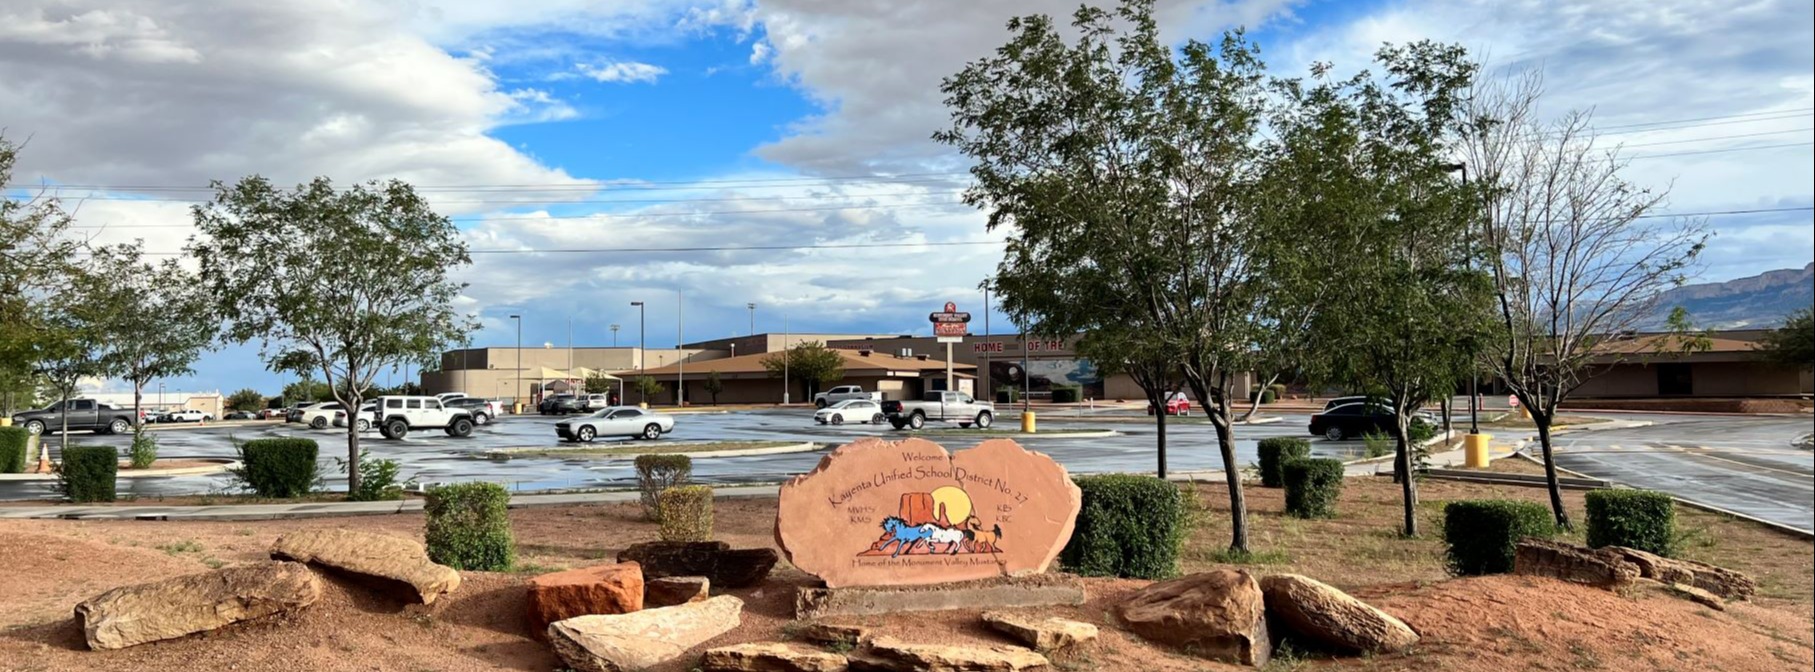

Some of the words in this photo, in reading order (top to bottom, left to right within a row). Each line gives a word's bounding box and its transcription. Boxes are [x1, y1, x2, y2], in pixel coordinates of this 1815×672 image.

[974, 342, 1003, 352] HOME
[1027, 341, 1040, 351] OF
[902, 452, 943, 462] Welcome
[828, 480, 872, 508] Kayenta
[874, 467, 912, 488] Unified
[915, 465, 952, 480] School
[955, 466, 992, 487] District
[994, 478, 1013, 497] No.
[1014, 491, 1028, 504] 27
[847, 506, 876, 514] MVHS
[850, 516, 872, 524] KMS
[852, 558, 876, 568] Home
[878, 558, 887, 567] of
[888, 558, 900, 567] the
[902, 558, 942, 567] Monument
[944, 557, 968, 568] Valley
